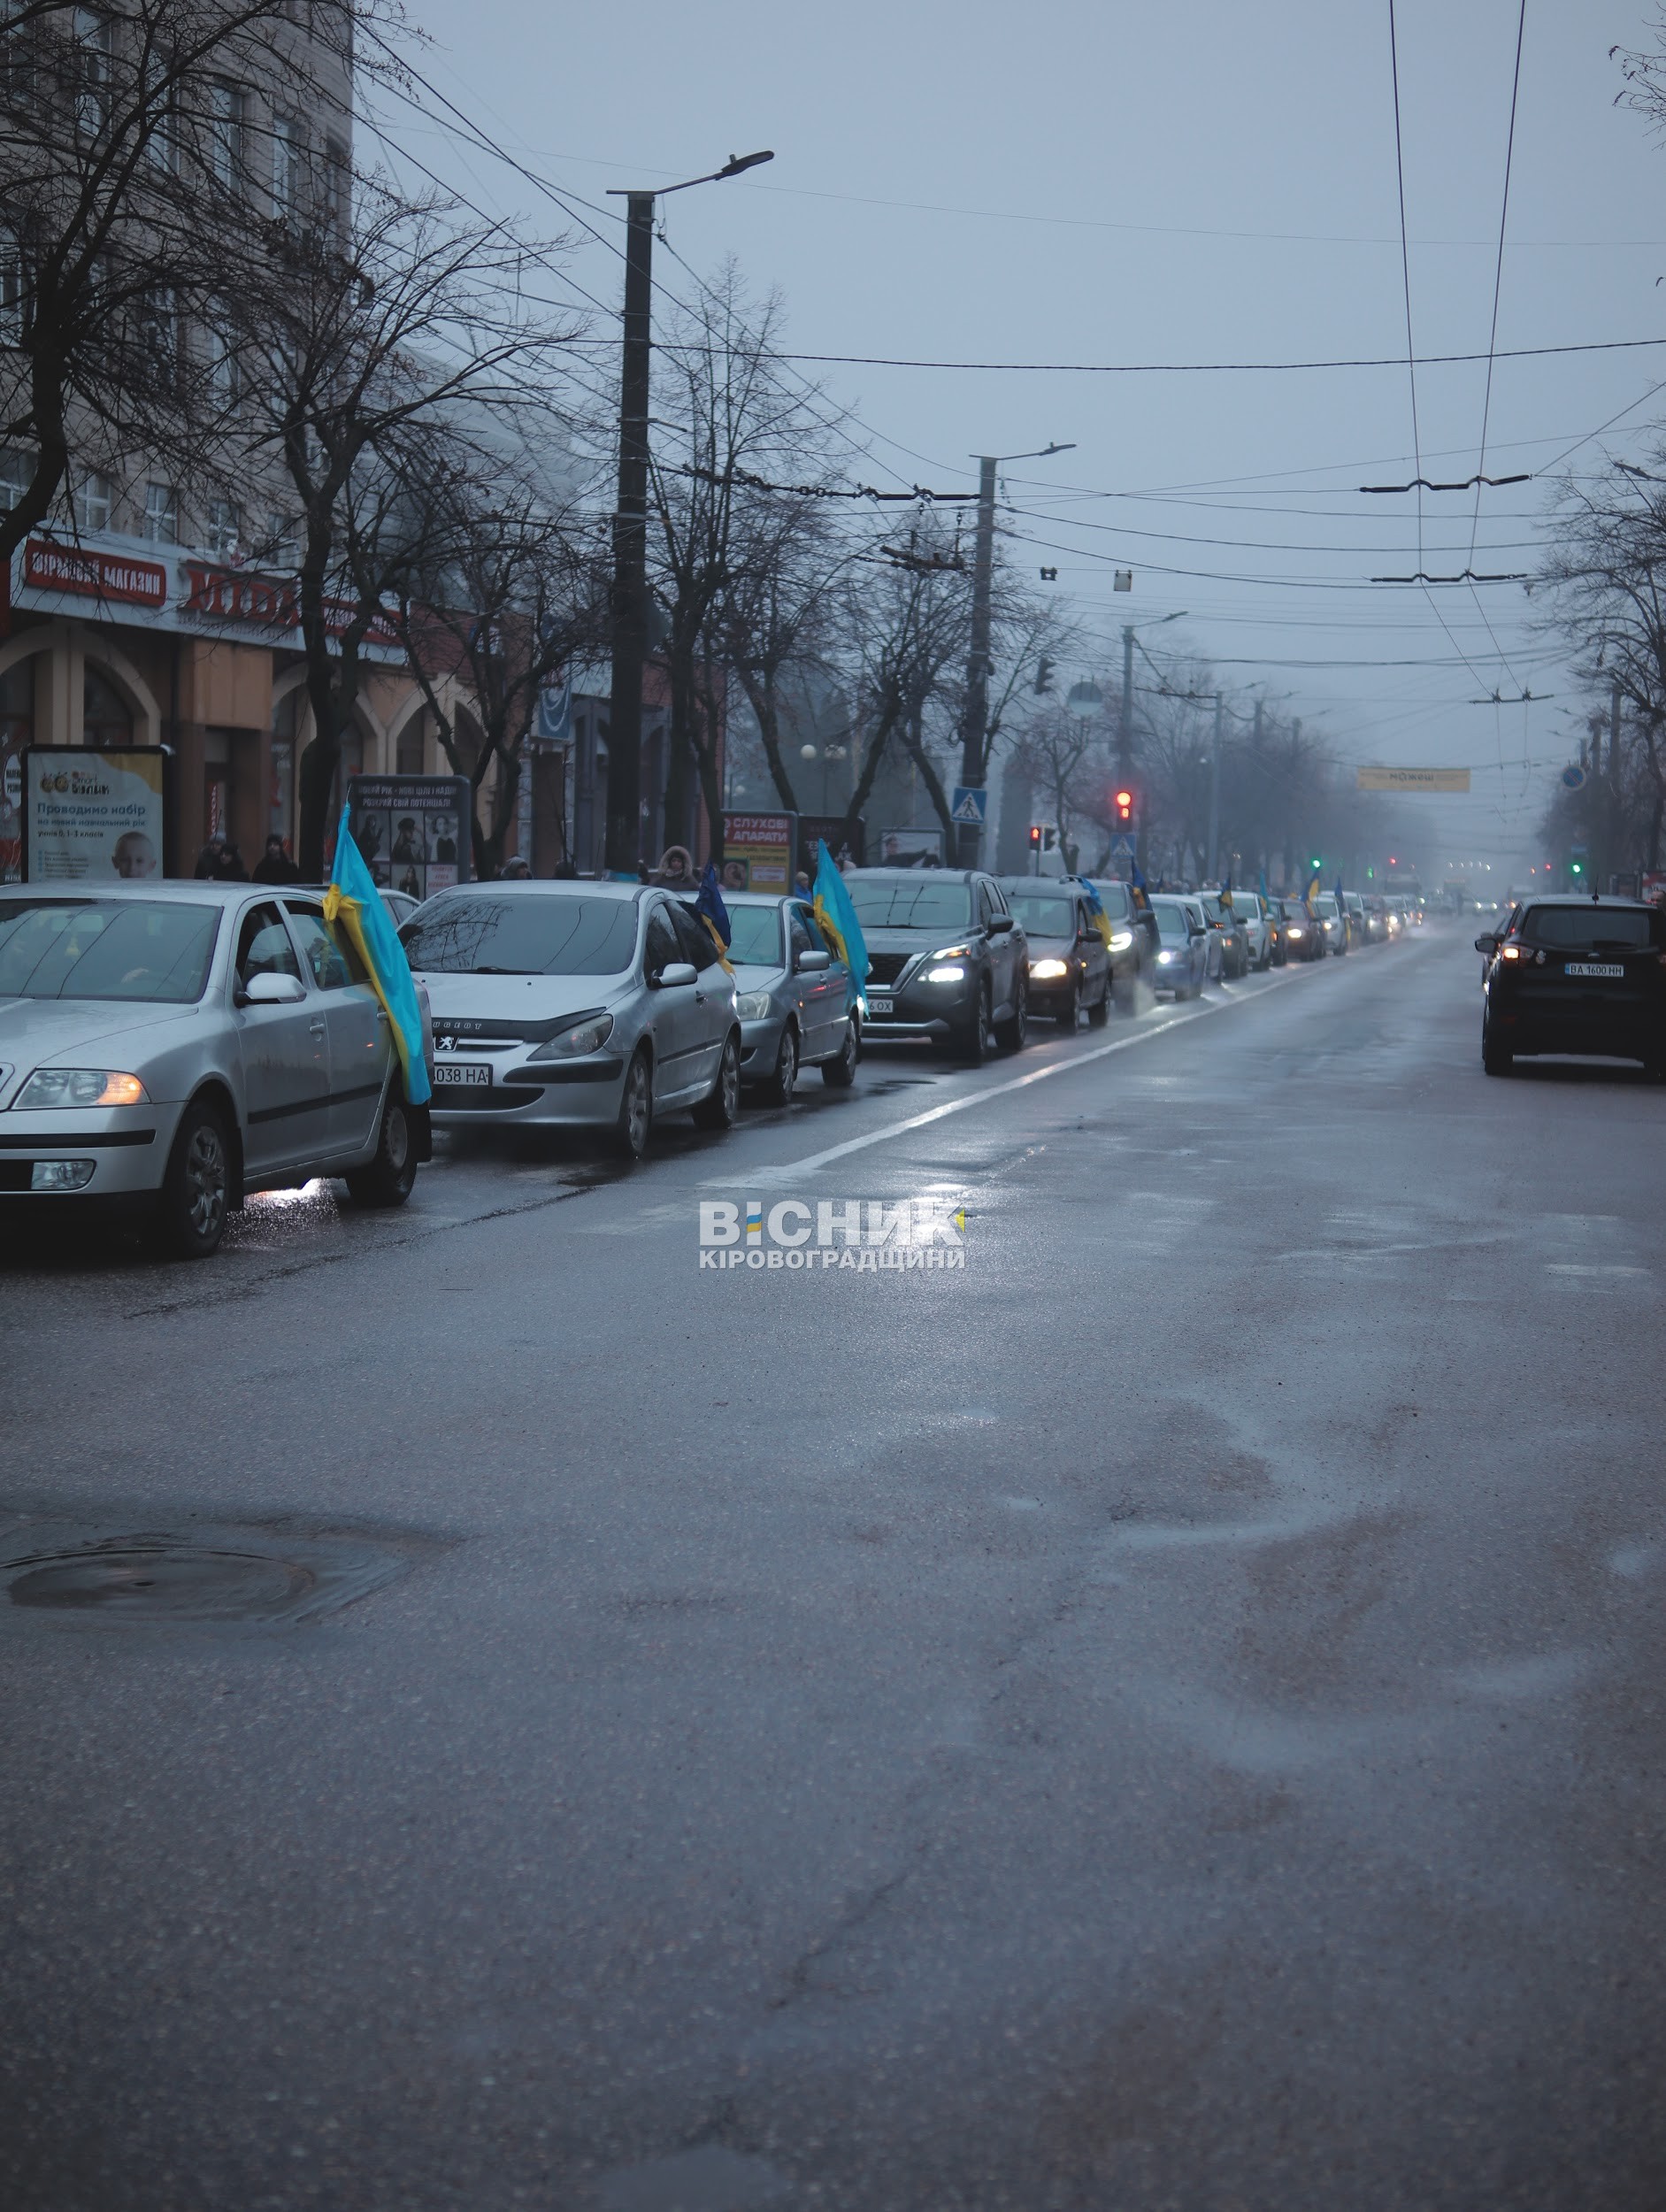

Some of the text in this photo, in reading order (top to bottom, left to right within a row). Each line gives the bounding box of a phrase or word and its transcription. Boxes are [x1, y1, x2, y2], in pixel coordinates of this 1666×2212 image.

[104, 565, 161, 595] МАГАЗИН
[363, 797, 392, 808] РОЗКРИЙ
[394, 797, 409, 808] СВІЙ
[37, 801, 146, 817] Проводимо набір
[51, 818, 76, 826] новий
[733, 818, 788, 829] СЛУХОВІ
[733, 831, 787, 842] АПАРАТИ
[1570, 965, 1622, 976] BA 1600 HH
[433, 1021, 482, 1030] UGEOT
[434, 1068, 487, 1084] 038 HA
